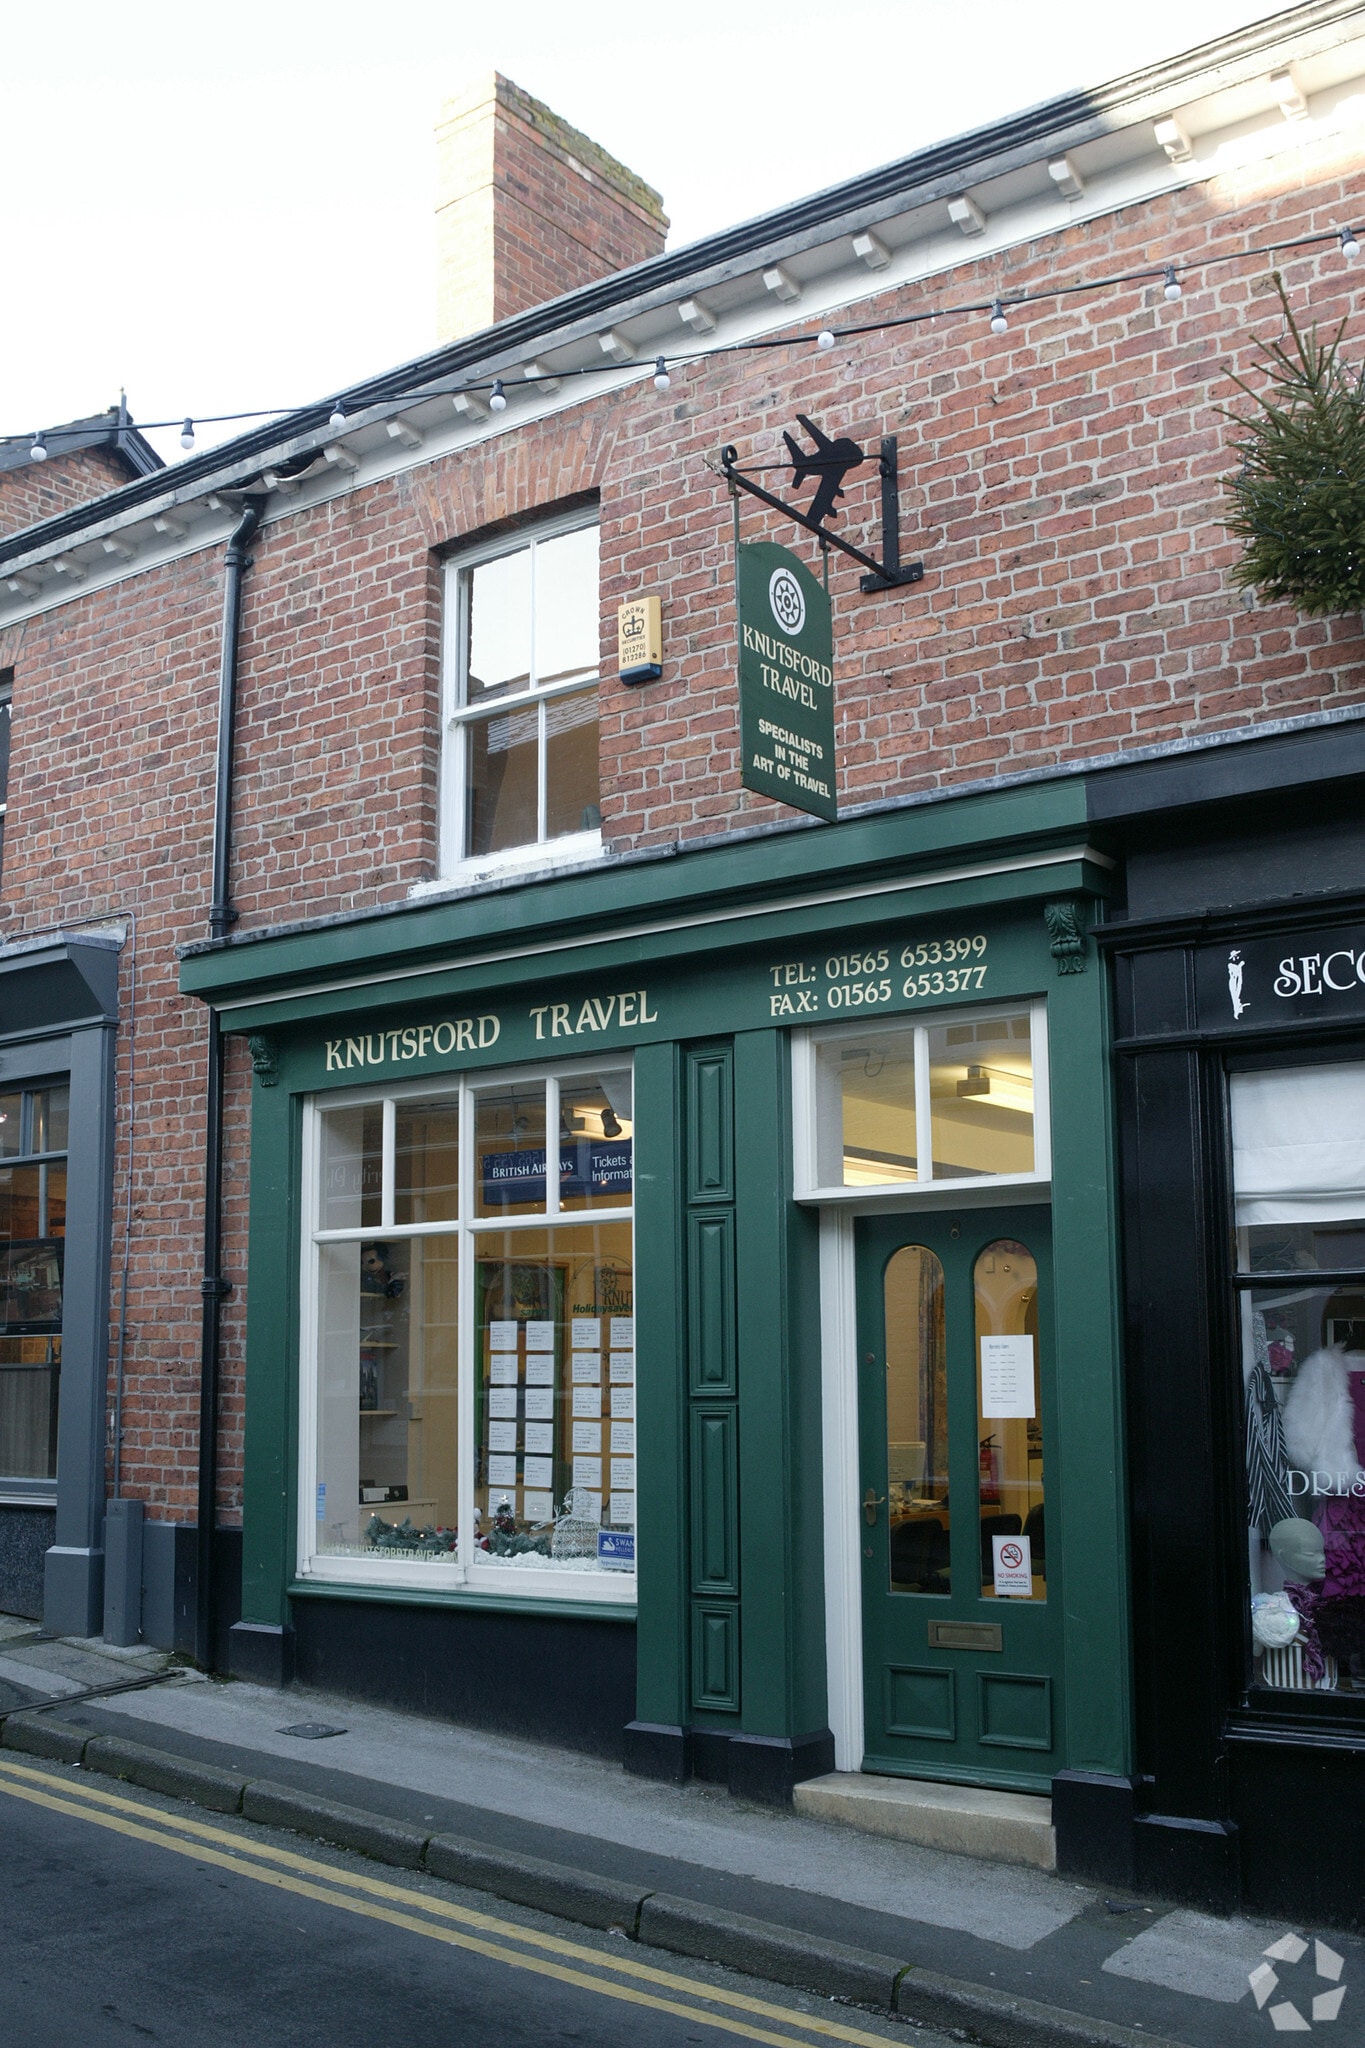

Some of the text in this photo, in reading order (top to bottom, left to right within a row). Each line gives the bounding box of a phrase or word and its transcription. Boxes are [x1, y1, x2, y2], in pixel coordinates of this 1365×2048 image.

[621, 606, 645, 620] CROWN
[621, 635, 646, 645] SECURITIES
[622, 643, 646, 656] (01270)
[742, 623, 832, 687] KNUTSFORD
[760, 663, 817, 710] TRAVEL
[758, 718, 823, 759] SPECIALISTS
[774, 744, 809, 771] IN THE
[752, 754, 831, 798] ART OF TRAVEL
[769, 935, 988, 987] TEL: 01565 653399
[1273, 949, 1365, 998] SEC
[769, 965, 988, 1017] FAX: 01565 653377
[325, 990, 659, 1071] KNUTSFORD TRAVEL
[492, 1161, 574, 1179] BRITISH AIRAYS
[592, 1155, 627, 1168] Tickets
